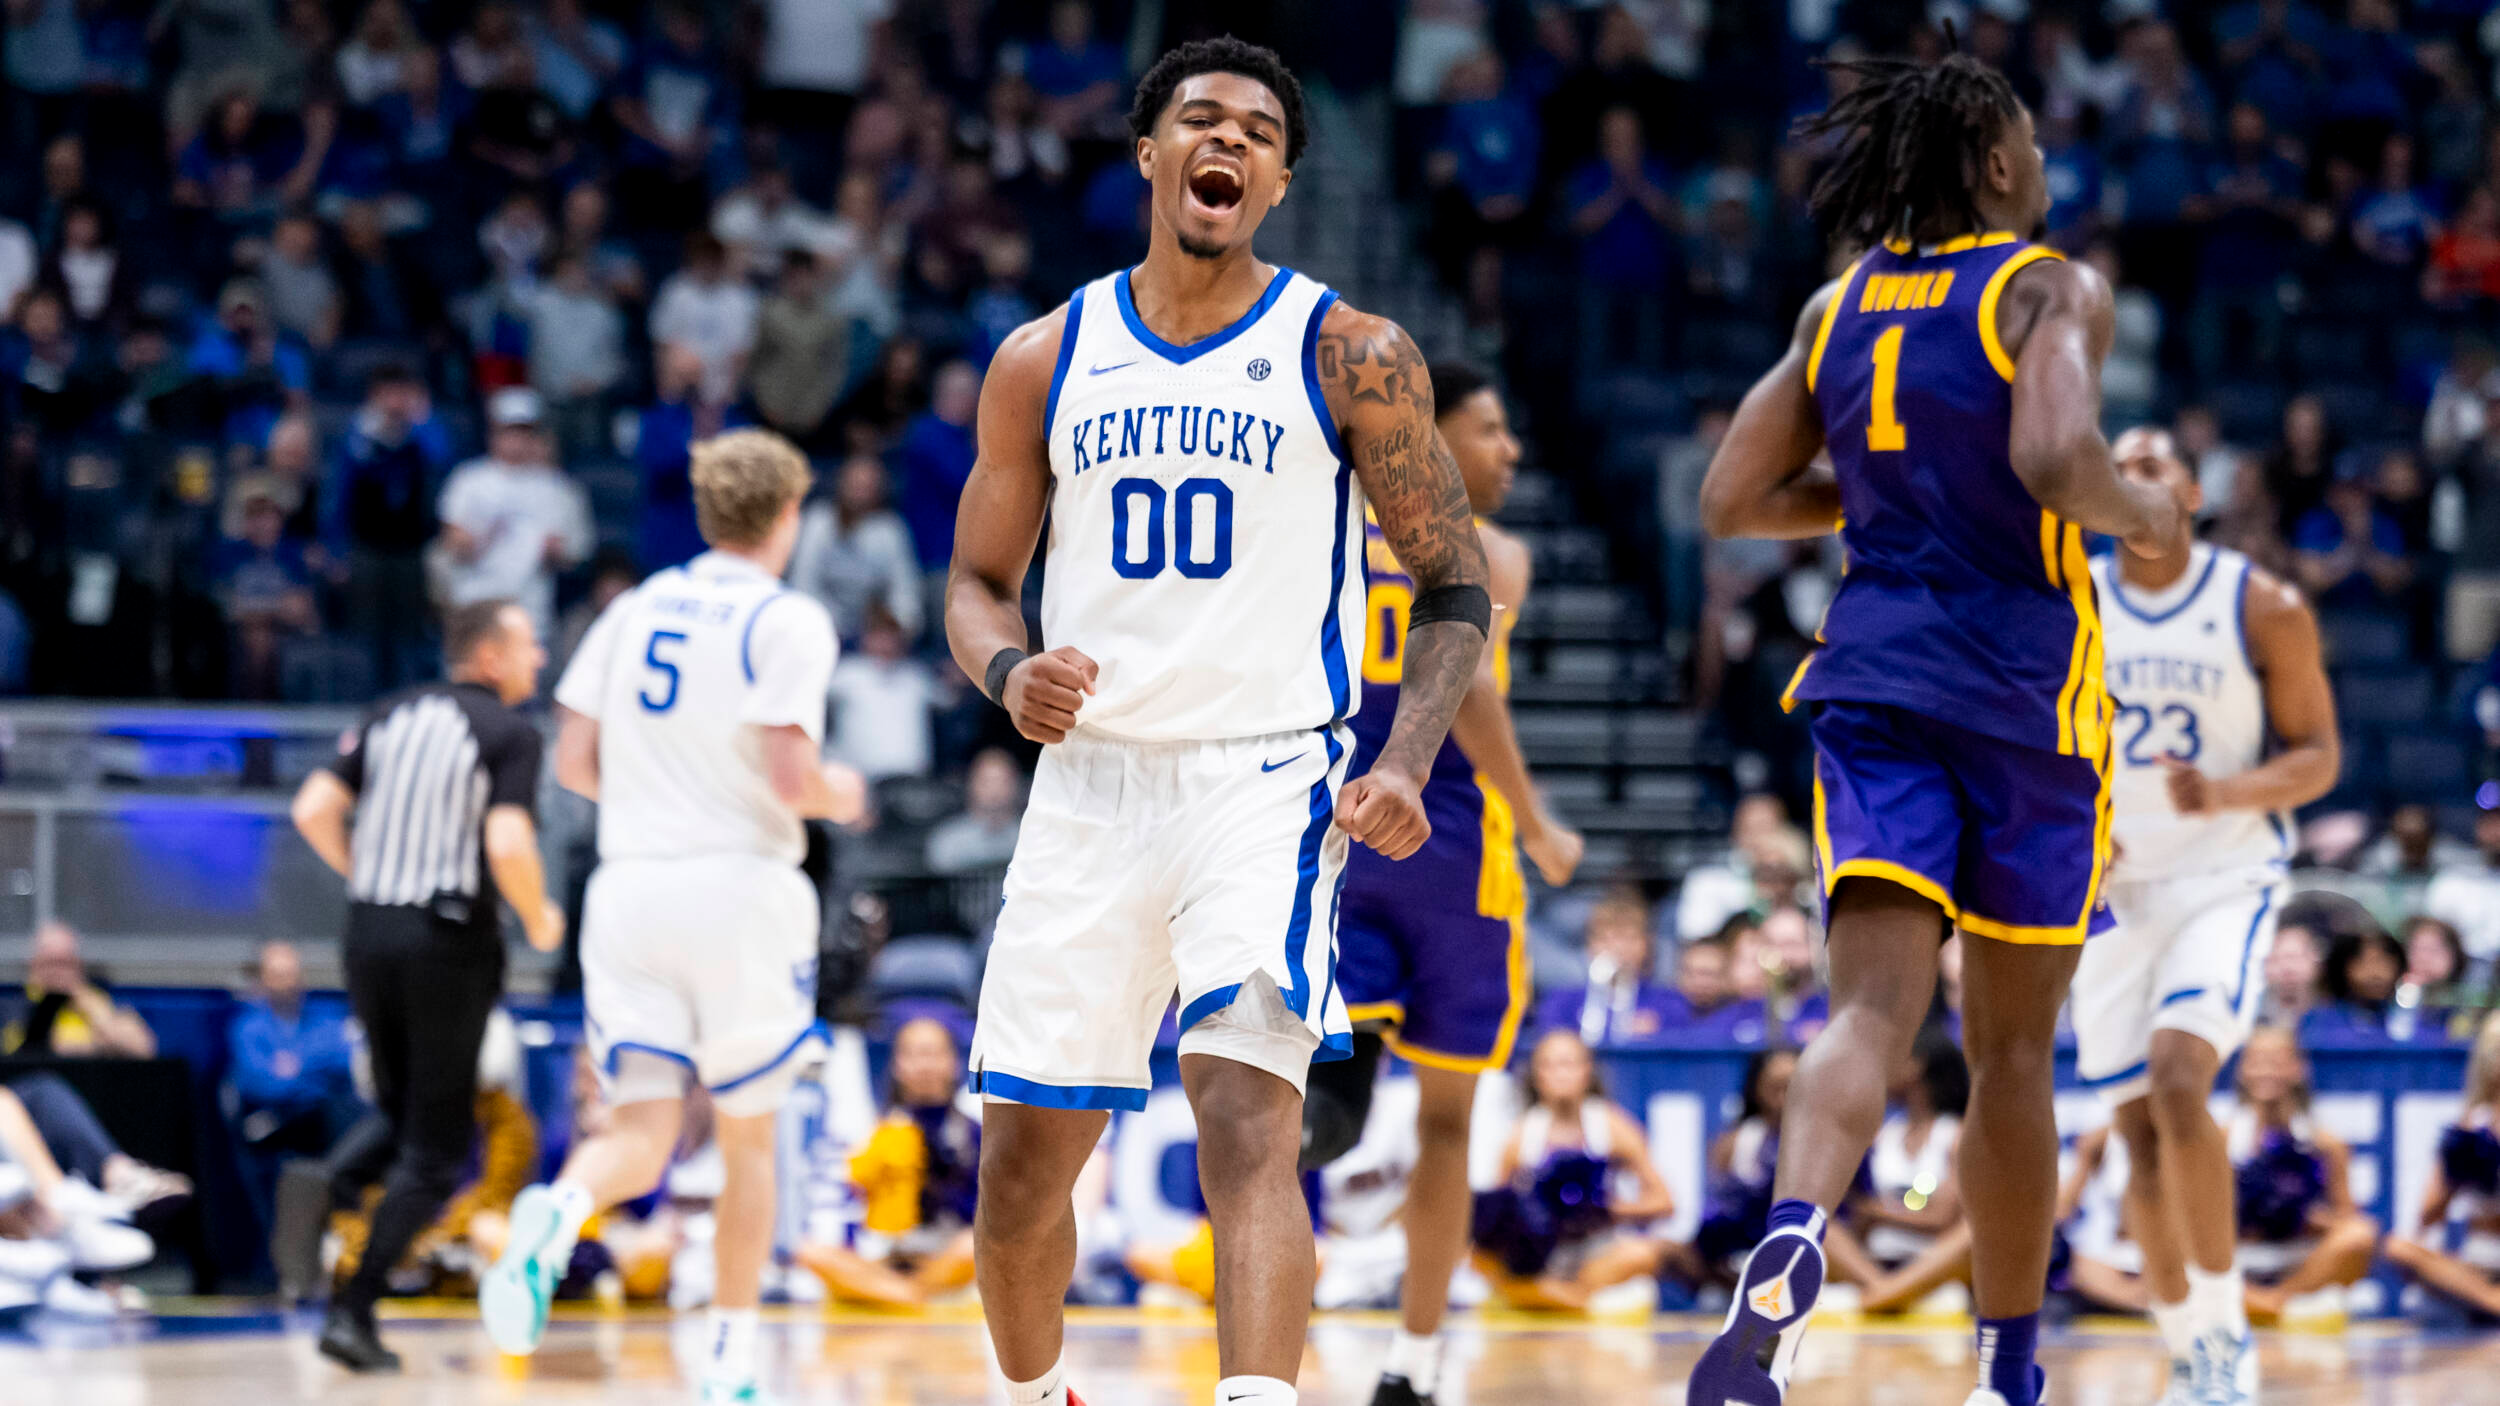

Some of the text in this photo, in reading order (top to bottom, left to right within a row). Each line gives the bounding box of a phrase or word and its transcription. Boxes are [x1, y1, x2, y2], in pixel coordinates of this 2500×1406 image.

[1247, 358, 1272, 381] SEC
[1866, 325, 1906, 452] 1
[1073, 405, 1285, 475] KENTUCKY
[1384, 460, 1408, 496] by
[1111, 477, 1234, 580] 00
[638, 630, 689, 713] 5
[2116, 702, 2203, 768] 23
